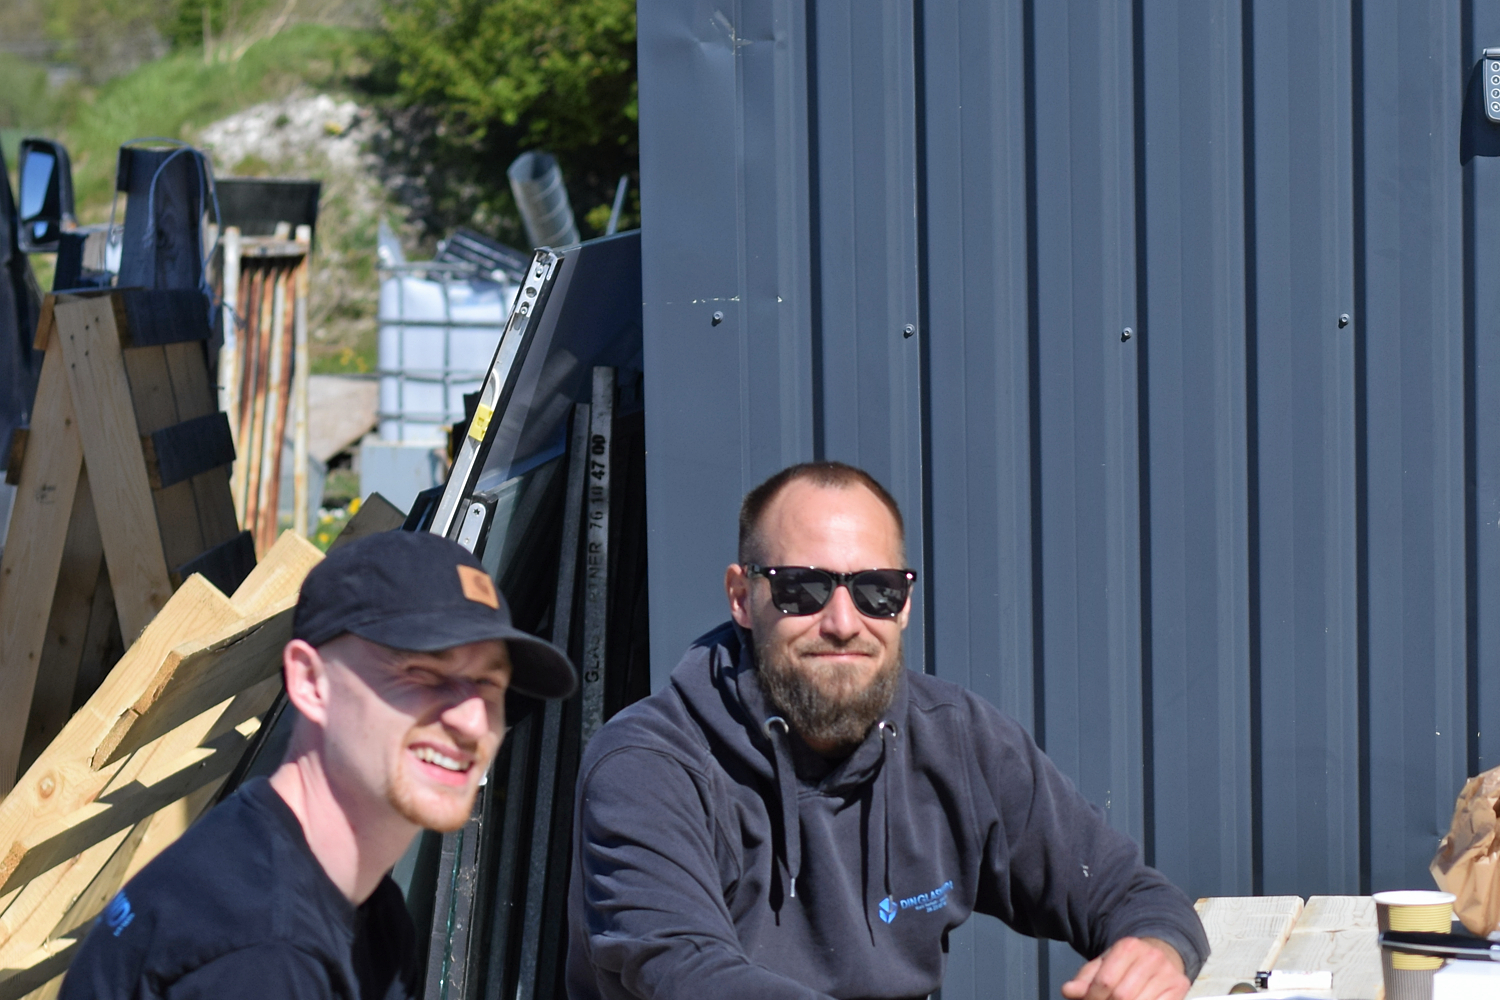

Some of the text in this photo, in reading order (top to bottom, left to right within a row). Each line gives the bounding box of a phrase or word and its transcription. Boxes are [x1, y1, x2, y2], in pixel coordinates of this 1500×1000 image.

[591, 434, 606, 455] 00
[590, 461, 605, 480] 47
[589, 511, 603, 529] 76
